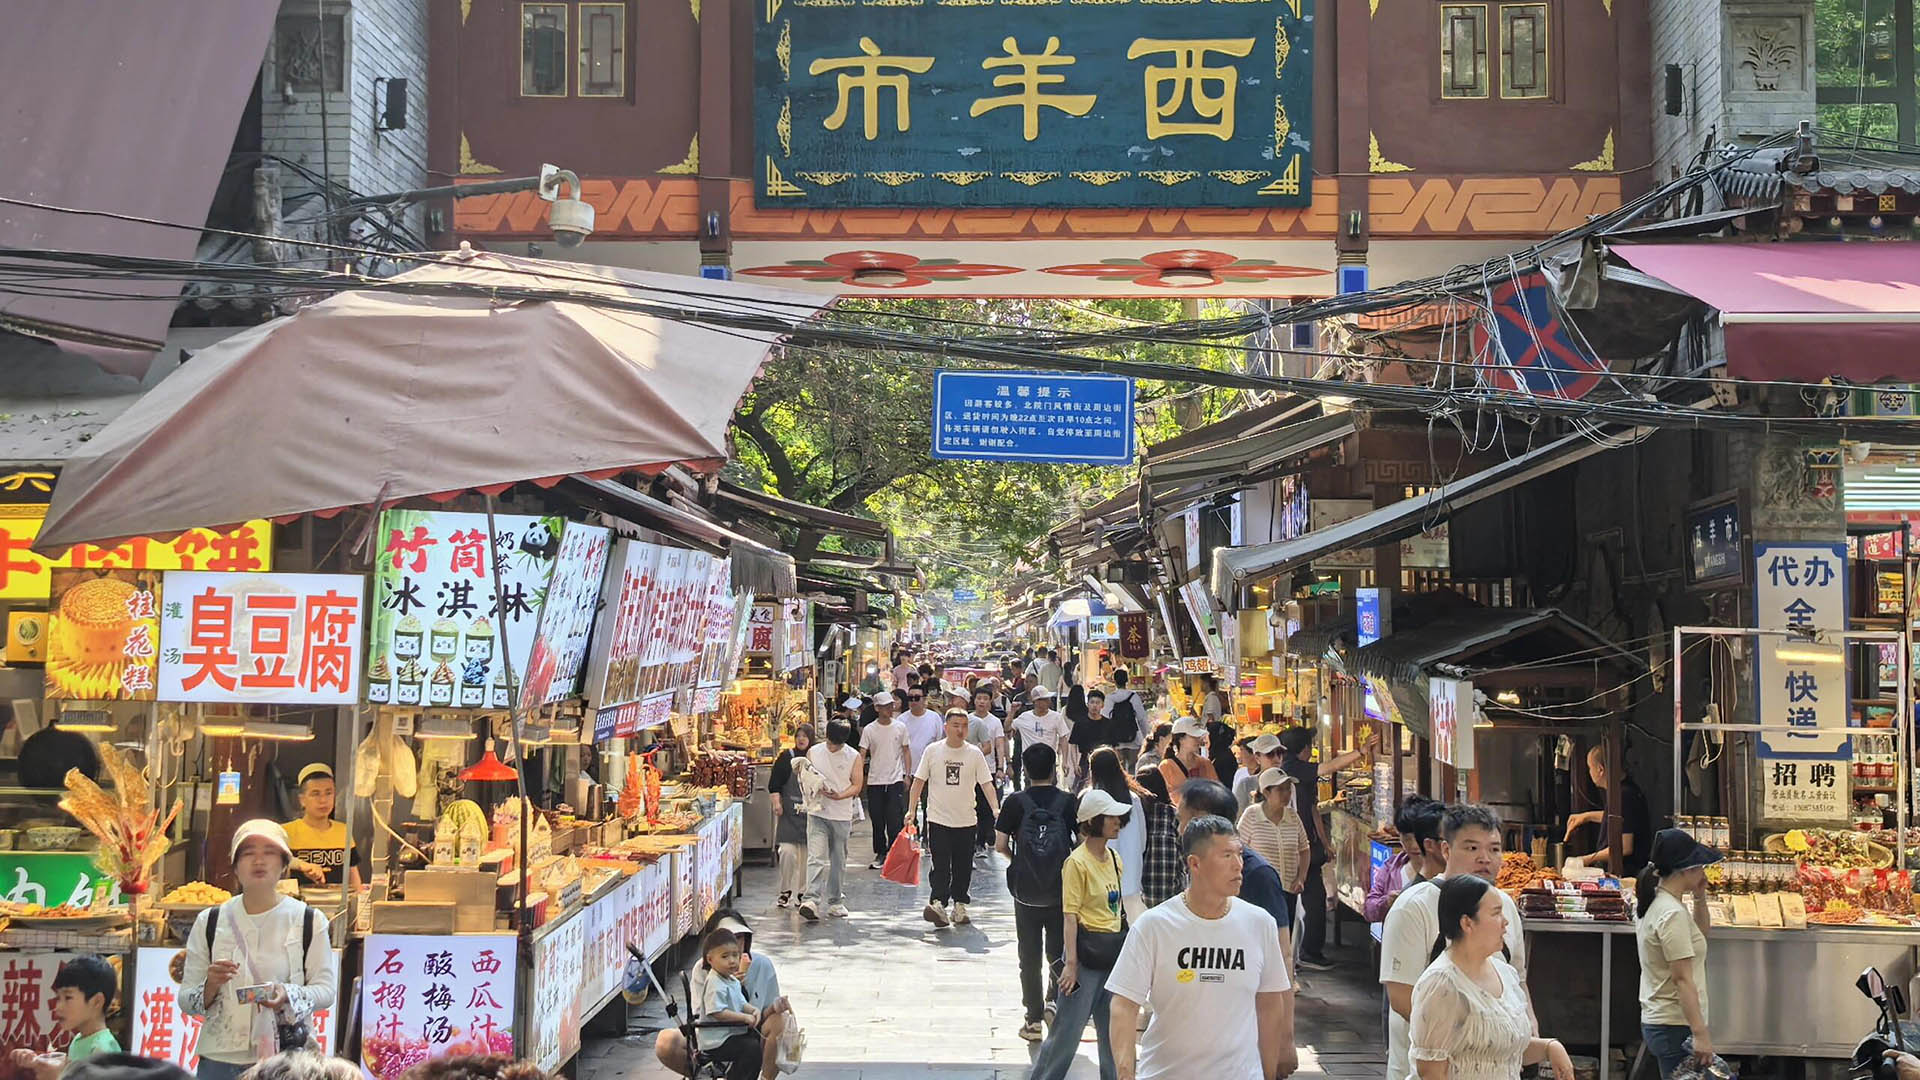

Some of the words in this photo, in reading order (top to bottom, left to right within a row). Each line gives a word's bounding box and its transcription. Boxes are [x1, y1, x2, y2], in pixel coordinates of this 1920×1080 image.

[996, 385, 1071, 398] 温馨提示
[386, 526, 488, 578] 竹筒
[492, 530, 515, 575] 奶茶
[1768, 555, 1835, 587] 代办
[382, 577, 533, 622] 冰淇淋
[123, 591, 154, 692] 桂花糕
[163, 602, 184, 665] 灌汤
[181, 586, 358, 694] 臭豆腐
[752, 625, 773, 651] 腐
[1127, 624, 1142, 644] 茶
[1772, 762, 1836, 788] 招聘
[1177, 947, 1246, 971] CHINA
[372, 948, 407, 1041] 石榴汁
[421, 949, 457, 1044] 酸梅汤
[465, 949, 503, 1044] 西瓜汁
